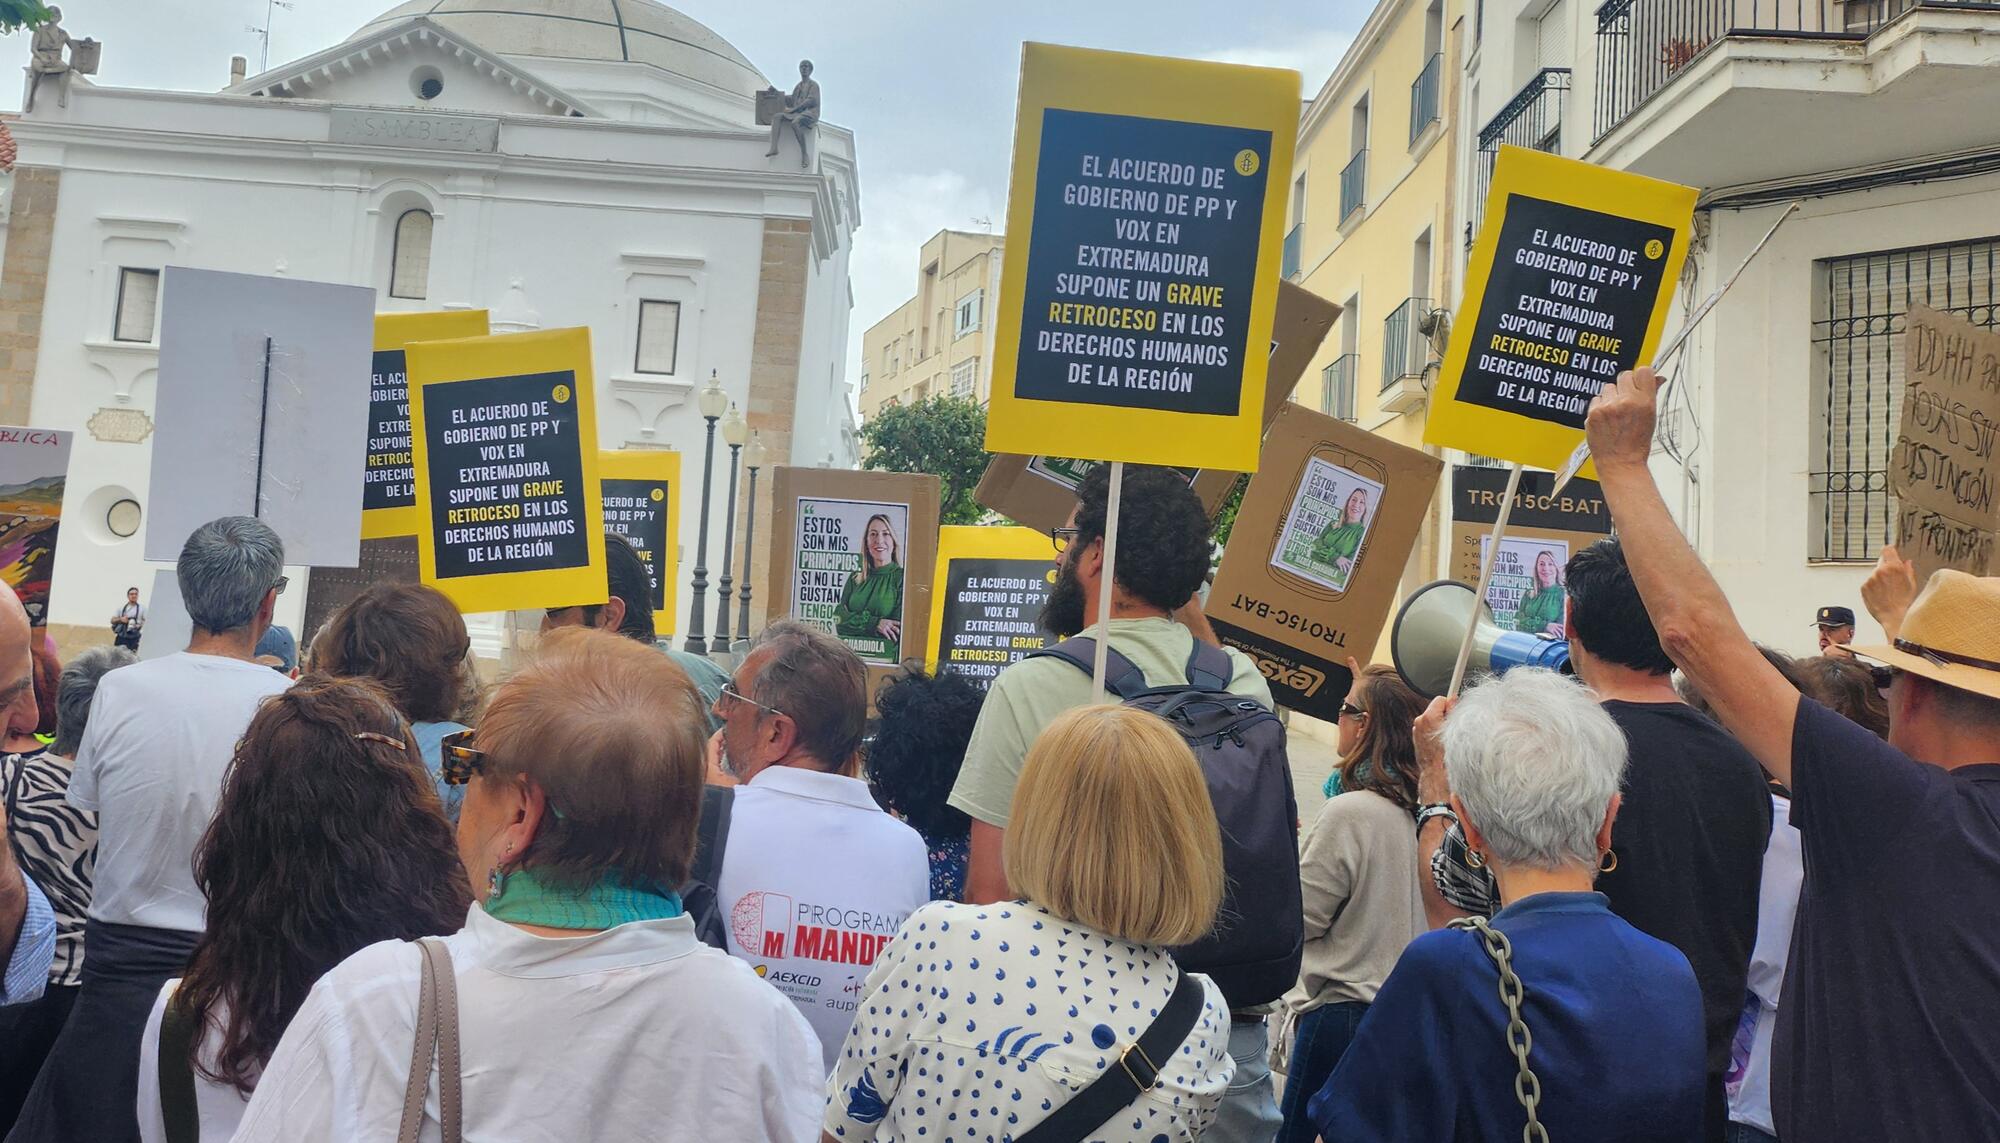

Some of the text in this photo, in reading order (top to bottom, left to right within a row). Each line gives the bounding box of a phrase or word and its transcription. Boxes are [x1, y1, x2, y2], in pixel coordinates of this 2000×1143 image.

[345, 116, 481, 143] ASAMBLEA
[1082, 155, 1225, 190] EL ACUERDO DE
[1064, 183, 1237, 220] GOBIERNO DE PP Y
[1115, 218, 1180, 244] VOX EN
[1533, 229, 1638, 267] EL ACUERDO DE
[1077, 244, 1209, 277] EXTREMADURA
[1516, 248, 1642, 290] GOBIERNO DE PP Y
[1056, 273, 1224, 308] SUPONE UN GRAVE
[1550, 278, 1598, 304] VOX EN
[1049, 301, 1225, 337] RETROCESO EN LOS
[1518, 294, 1614, 331] EXTREMADURA
[1499, 313, 1622, 355] SUPONE UN GRAVE
[1038, 330, 1229, 367] DERECHOS HUMANOS
[1491, 334, 1617, 376] RETROCESO EN LOS
[1914, 324, 1975, 386] DDHH
[372, 374, 383, 385] EL
[1068, 363, 1193, 393] DE LA REGIÓN
[1479, 354, 1606, 395] DERECHOS HUMAN
[370, 389, 409, 402] OBIER
[1497, 381, 1515, 399] DE
[1518, 387, 1534, 403] LA
[397, 404, 410, 416] VO
[452, 401, 549, 424] EL ACUERDO DE
[379, 420, 411, 433] EXTRE
[444, 420, 560, 444] GOBIERNO DE PP Y
[0, 430, 57, 446] BLICA
[370, 436, 412, 450] SUPONE
[369, 453, 413, 466] RETROC
[480, 444, 525, 461] VOX EN
[366, 467, 415, 482] DERECHO
[460, 461, 550, 483] EXTREMADURA
[386, 484, 415, 497] DE LA
[1311, 474, 1336, 492] ESTOS
[450, 480, 564, 504] SUPONE UN GRAVE
[1306, 485, 1338, 505] SON MIS
[601, 497, 647, 507] UERDO DE
[448, 500, 568, 524] RETROCESO EN LOS
[620, 511, 631, 520] DE
[634, 511, 646, 520] PP
[649, 511, 655, 520] Y
[1298, 509, 1326, 528] SI NO LE
[445, 519, 575, 544] DERECHOS HUMANOS
[617, 524, 628, 534] EN
[804, 517, 841, 534] ESTOS
[1294, 521, 1322, 537] GUSTAN
[468, 539, 553, 562] DE LA REGIÓN
[803, 534, 848, 551] SON MIS
[801, 553, 862, 571] PRINCIPIOS.
[1496, 552, 1518, 563] STOS
[1493, 563, 1523, 575] ON MIS
[801, 571, 843, 587] SI NO LE
[967, 578, 1042, 590] EL ACUERDO DE
[801, 587, 841, 603] GUSTAN
[958, 592, 1049, 604] GOBIERNO DE PP Y
[1489, 588, 1520, 599] SI NO LE
[800, 603, 833, 619] TENGO
[984, 607, 1018, 618] VOX EN
[1489, 599, 1518, 610] GUSTAN
[1494, 610, 1513, 621] ENGO
[965, 620, 1036, 634] EXTREMADURA
[954, 635, 1044, 648] SUPONE UN GRAVE
[951, 649, 1024, 662] RETROCESO EN
[763, 925, 894, 966] M MANDE
[770, 971, 821, 987] AEXCID
